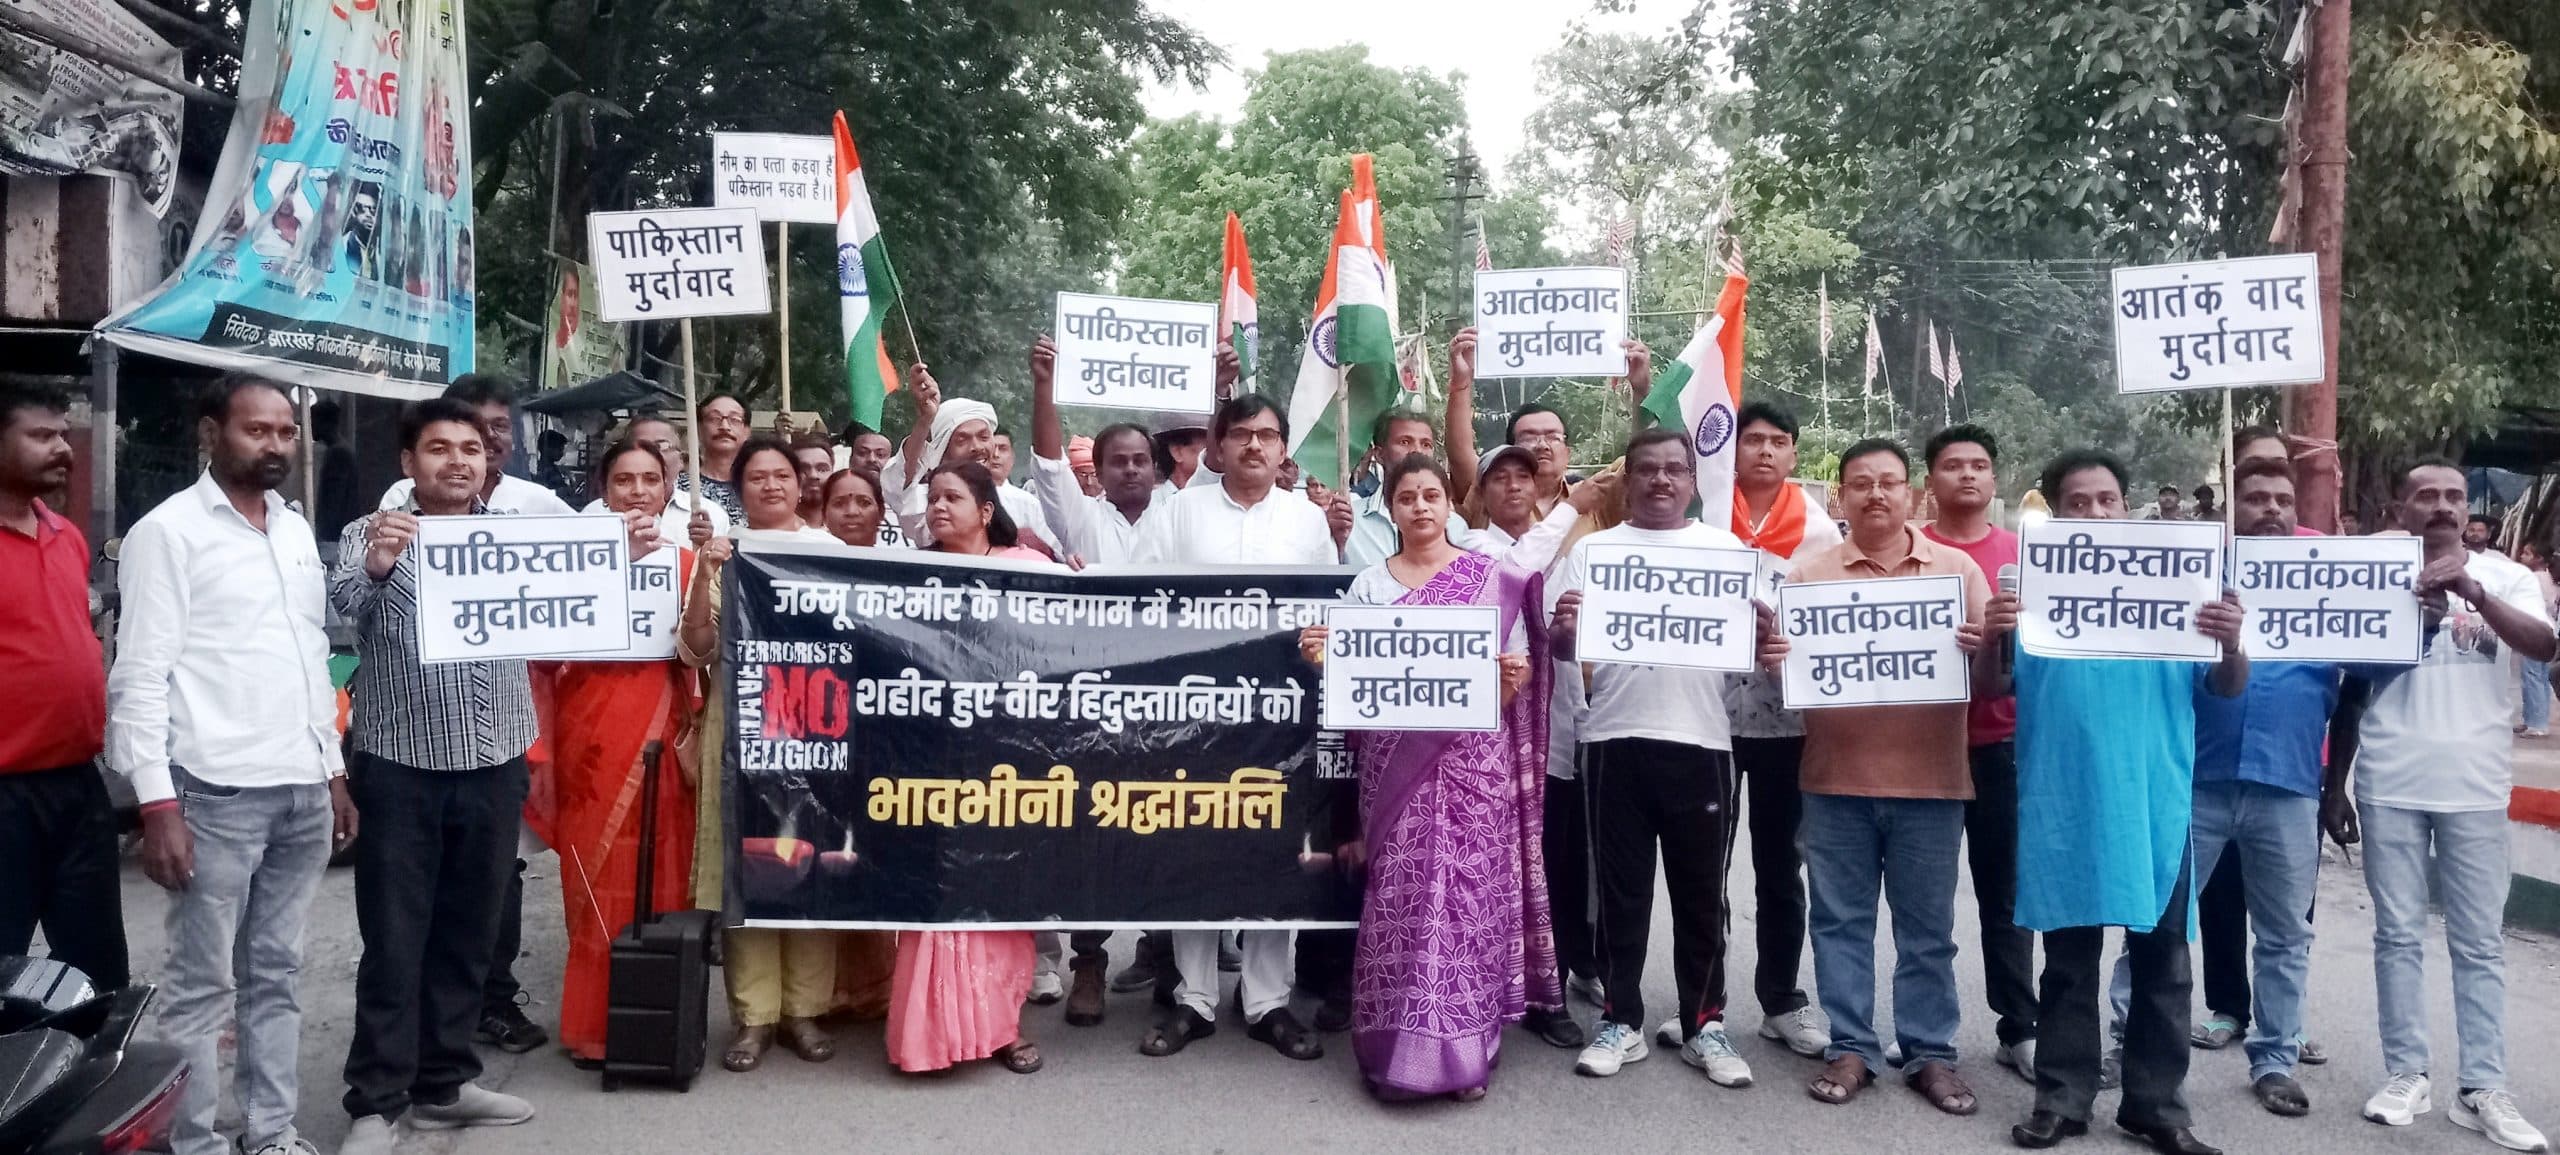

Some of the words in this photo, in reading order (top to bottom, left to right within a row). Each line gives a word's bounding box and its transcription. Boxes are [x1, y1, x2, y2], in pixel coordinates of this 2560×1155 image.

[719, 150, 738, 172] नीम
[744, 156, 757, 173] का
[763, 157, 785, 173] पत्ता
[606, 218, 743, 259] पाकिस्तान
[626, 259, 734, 312] मुर्दावाद
[1482, 278, 1620, 316] आतंकवाद
[2121, 274, 2224, 320] आतंक
[2243, 276, 2306, 311] वाद
[1065, 307, 1210, 348] पाकिस्तान
[1498, 321, 1605, 368] मुर्दाबाद
[2160, 317, 2293, 381] मुर्दावाद
[1081, 353, 1190, 395] मुर्दाबाद
[425, 531, 619, 576] पाकिस्तान
[2028, 533, 2214, 578] पाकिस्तान
[2240, 548, 2413, 590] आतंकवाद
[1590, 555, 1752, 599] पाकिस्तान
[452, 585, 598, 646] मुर्दाबाद
[770, 579, 855, 630] जम्मू
[854, 577, 964, 622] कश्मीर
[964, 579, 1001, 622] के
[1005, 590, 1136, 628] पहलगाम
[1140, 588, 1175, 629] में
[1177, 588, 1271, 631] आतंकी
[1789, 592, 1955, 636] आतंकवाद
[2048, 586, 2190, 638] मुर्दाबाद
[2259, 598, 2391, 649] मुर्दाबाद
[1333, 617, 1491, 659] आतंकवाद
[1606, 604, 1727, 651] मुर्दाबाद
[737, 640, 853, 664] TERRORISTS
[1809, 641, 1937, 696] मुर्दाबाद
[738, 664, 763, 739] HAVE
[764, 665, 849, 739] NO
[856, 667, 946, 717] शहीद
[949, 680, 999, 728] हुए
[1002, 670, 1063, 719] वीर
[1068, 670, 1258, 733] हिंदुस्तानियों
[1259, 677, 1305, 724] को
[1351, 667, 1471, 718] मुर्दाबाद
[740, 739, 848, 771] RELIGION
[868, 764, 1079, 828] भावभीनी
[1088, 767, 1287, 834] श्रद्धांजलि
